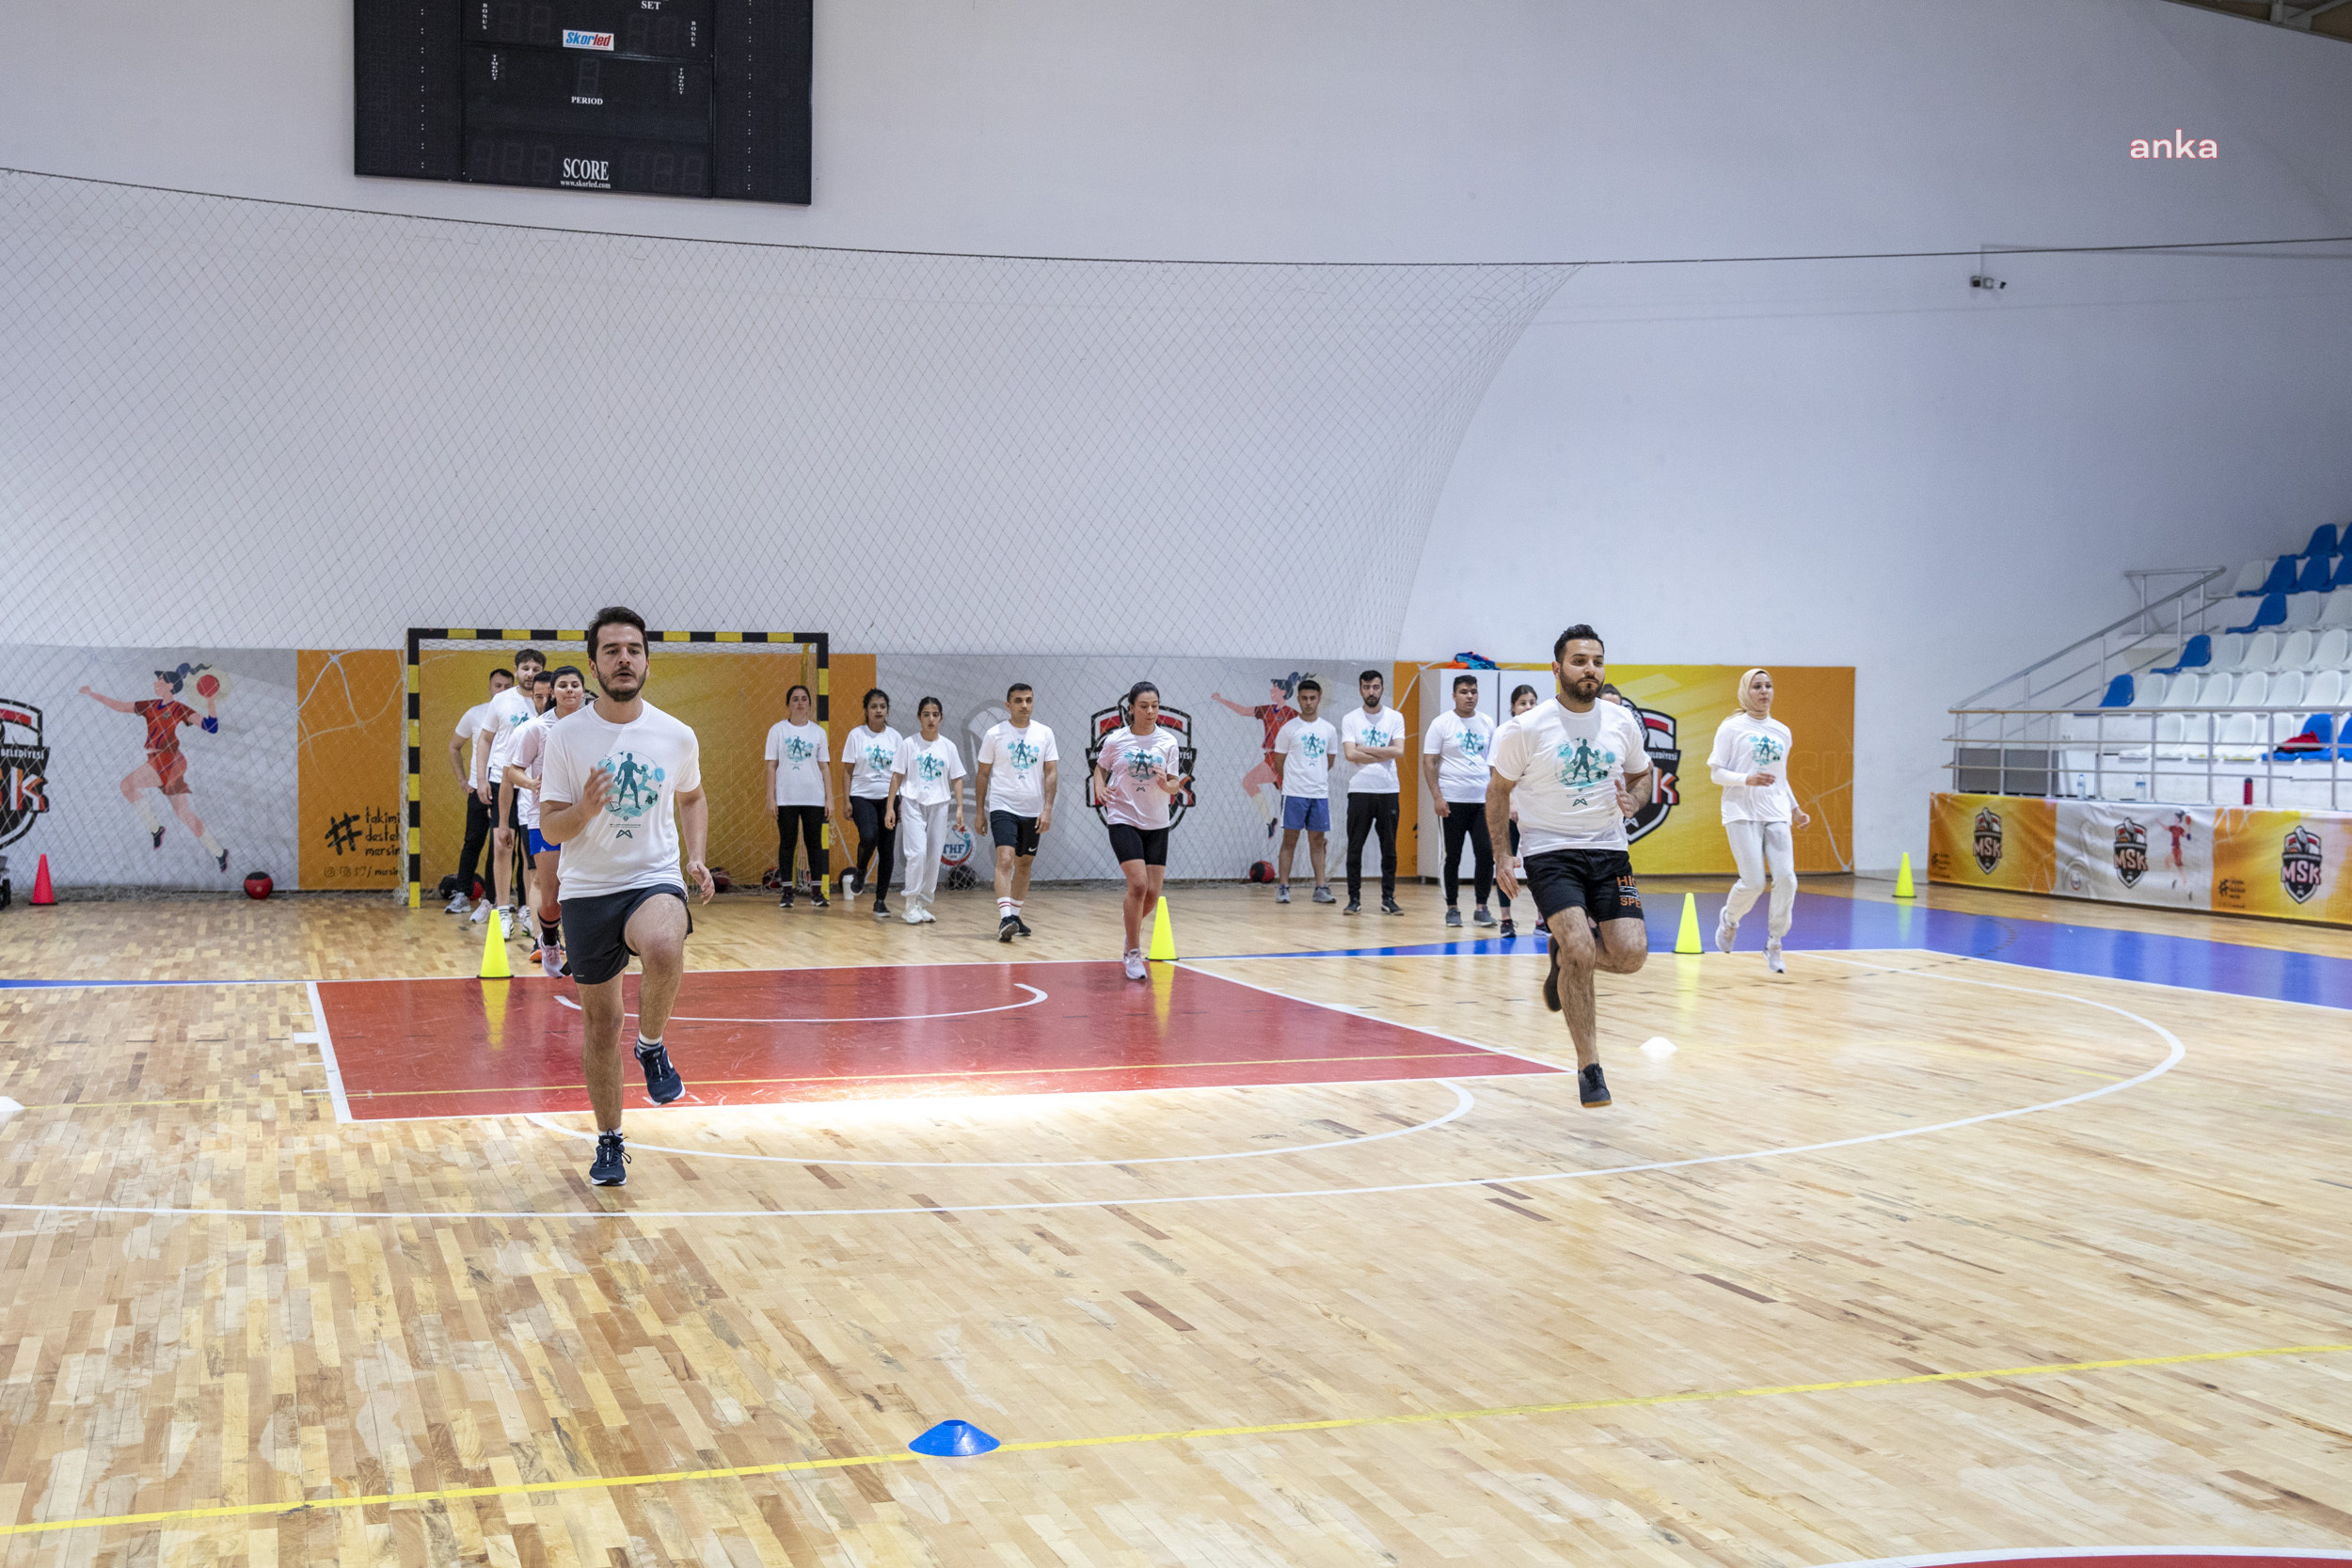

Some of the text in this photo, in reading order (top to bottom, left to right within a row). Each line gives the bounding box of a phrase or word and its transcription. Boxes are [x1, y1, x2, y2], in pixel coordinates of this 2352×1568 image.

[641, 0, 661, 10] SET
[565, 31, 612, 47] Skorled
[571, 96, 604, 105] PERIOD
[563, 157, 610, 182] SCORE
[560, 180, 612, 189] www.skorled.com
[1973, 836, 2003, 860] MSK
[2113, 848, 2149, 872] MSK
[2280, 860, 2321, 885] MSK
